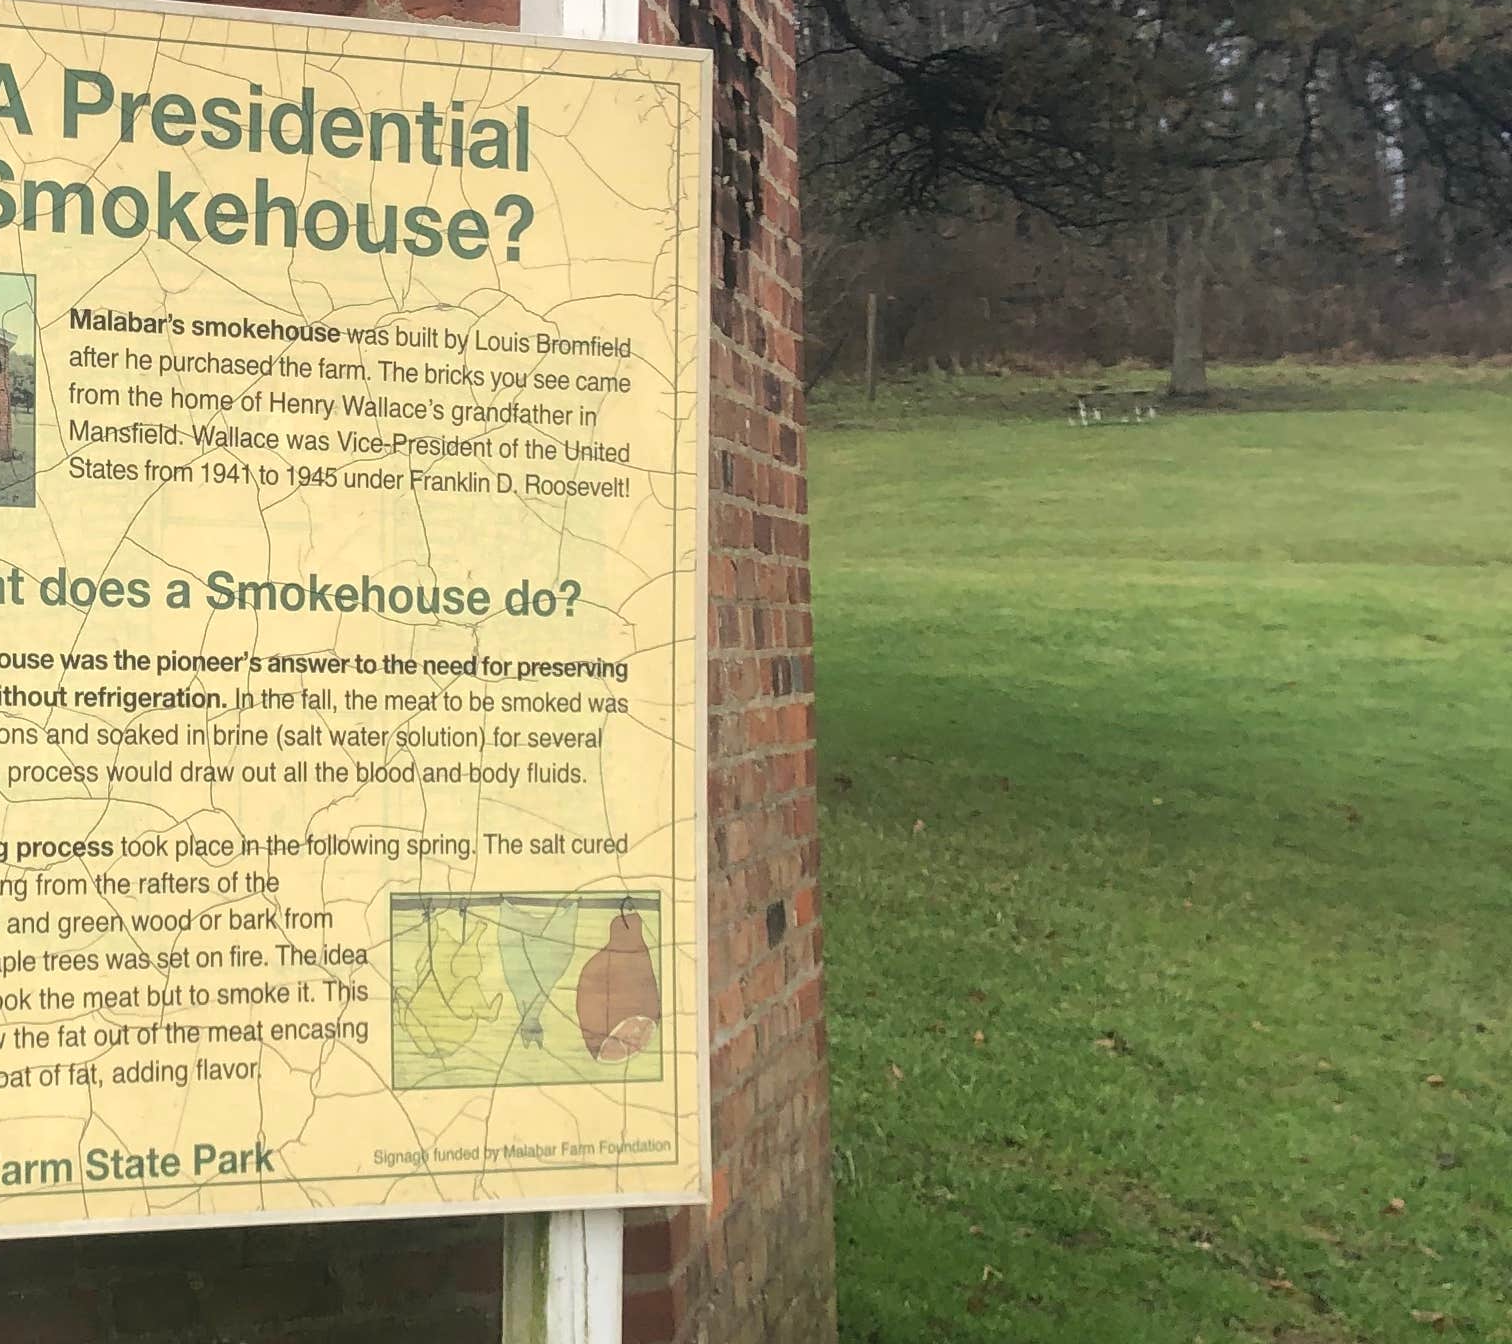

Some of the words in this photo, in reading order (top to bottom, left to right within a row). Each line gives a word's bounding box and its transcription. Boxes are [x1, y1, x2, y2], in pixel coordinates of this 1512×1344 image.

[63, 67, 531, 173] Presidential
[68, 308, 185, 335] Malabar's
[191, 315, 341, 343] smokehouse
[346, 328, 389, 346] was
[395, 326, 438, 348] built
[444, 328, 470, 355] by
[475, 330, 530, 353] Louis
[536, 333, 631, 358] Bromfield
[68, 346, 119, 369] after
[125, 349, 152, 371] he
[159, 350, 273, 382] purchased
[278, 356, 312, 378] the
[318, 358, 371, 381] farm.
[377, 361, 418, 383] The
[424, 363, 485, 386] bricks
[490, 371, 528, 393] you
[532, 373, 570, 390] see
[575, 376, 631, 393] came
[68, 383, 120, 406] from
[127, 385, 163, 408] the
[171, 387, 234, 411] home
[239, 390, 263, 412] of
[269, 392, 336, 420] Henry
[341, 395, 444, 420] Wallace's
[451, 400, 573, 430] grandfather
[579, 406, 596, 426] in
[68, 420, 184, 445] Mansfield.
[190, 425, 279, 449] Wallace
[286, 434, 330, 451] was
[337, 431, 492, 457] Vice-President
[498, 437, 519, 458] of
[525, 439, 558, 460] the
[563, 440, 630, 462] United
[68, 458, 138, 481] States
[144, 461, 193, 483] from
[200, 463, 254, 485] 1941
[258, 466, 279, 486] to
[286, 466, 337, 488] 1945
[344, 468, 404, 490] under
[409, 470, 490, 493] Franklin
[496, 473, 517, 494] D.
[525, 474, 630, 498] Roosevelt!
[39, 566, 151, 609] does
[166, 579, 190, 609] a
[206, 569, 490, 615] Smokehouse
[504, 576, 582, 617] do?
[59, 654, 108, 670] was
[112, 649, 151, 670] the
[156, 650, 263, 677] pioneer's
[267, 657, 350, 673] answer
[354, 654, 377, 673] to
[381, 653, 418, 674] the
[422, 654, 477, 674] need
[482, 655, 513, 675] for
[517, 656, 628, 681] preserving
[74, 687, 227, 713] refrigeration.
[235, 688, 255, 708] In
[259, 689, 295, 709] the
[299, 689, 337, 712] fall,
[344, 689, 377, 710] the
[384, 691, 438, 710] meat
[443, 692, 462, 710] to
[469, 691, 494, 711] be
[501, 691, 582, 711] smoked
[587, 697, 628, 712] was
[44, 724, 88, 744] and
[96, 724, 179, 745] soaked
[186, 725, 208, 745] in
[213, 725, 268, 745] brine
[276, 725, 322, 750] (salt
[327, 727, 390, 746] water
[395, 726, 486, 751] solution)
[492, 727, 522, 746] for
[527, 727, 602, 747] several
[8, 767, 98, 788] process
[106, 762, 172, 782] would
[180, 762, 235, 782] draw
[241, 763, 276, 782] out
[283, 762, 307, 782] all
[315, 762, 349, 782] the
[354, 762, 417, 782] blood
[422, 762, 462, 782] and
[469, 762, 520, 787] body
[527, 762, 587, 782] fluids.
[16, 841, 114, 863] process
[120, 836, 168, 857] took
[175, 836, 234, 862] place
[238, 836, 260, 856] in
[264, 835, 301, 856] the
[305, 835, 400, 860] following
[406, 834, 478, 860] spring.
[484, 834, 523, 854] The
[529, 834, 565, 853] salt
[571, 833, 627, 853] cured
[42, 951, 99, 971] trees
[105, 954, 151, 970] was
[156, 949, 190, 969] set
[195, 952, 223, 968] on
[229, 946, 268, 967] fire.
[274, 945, 317, 966] The
[321, 944, 367, 965] idea
[38, 988, 75, 1009] the
[83, 988, 140, 1008] meat
[147, 985, 182, 1006] but
[189, 986, 210, 1005] to
[217, 983, 290, 1005] smoke
[297, 982, 315, 1002] it.
[325, 981, 367, 1002] This
[13, 1027, 50, 1049] the
[57, 1026, 86, 1048] fat
[93, 1026, 130, 1046] out
[135, 1024, 159, 1045] of
[164, 1023, 202, 1044] the
[207, 1022, 263, 1043] meat
[270, 1018, 367, 1046] encasing
[86, 1146, 180, 1181] State
[194, 1141, 274, 1176] Park
[433, 1145, 480, 1162] funded
[483, 1144, 500, 1163] by
[503, 1141, 556, 1158] Malabar
[561, 1139, 595, 1155] Farm
[599, 1136, 670, 1153] Foundation
